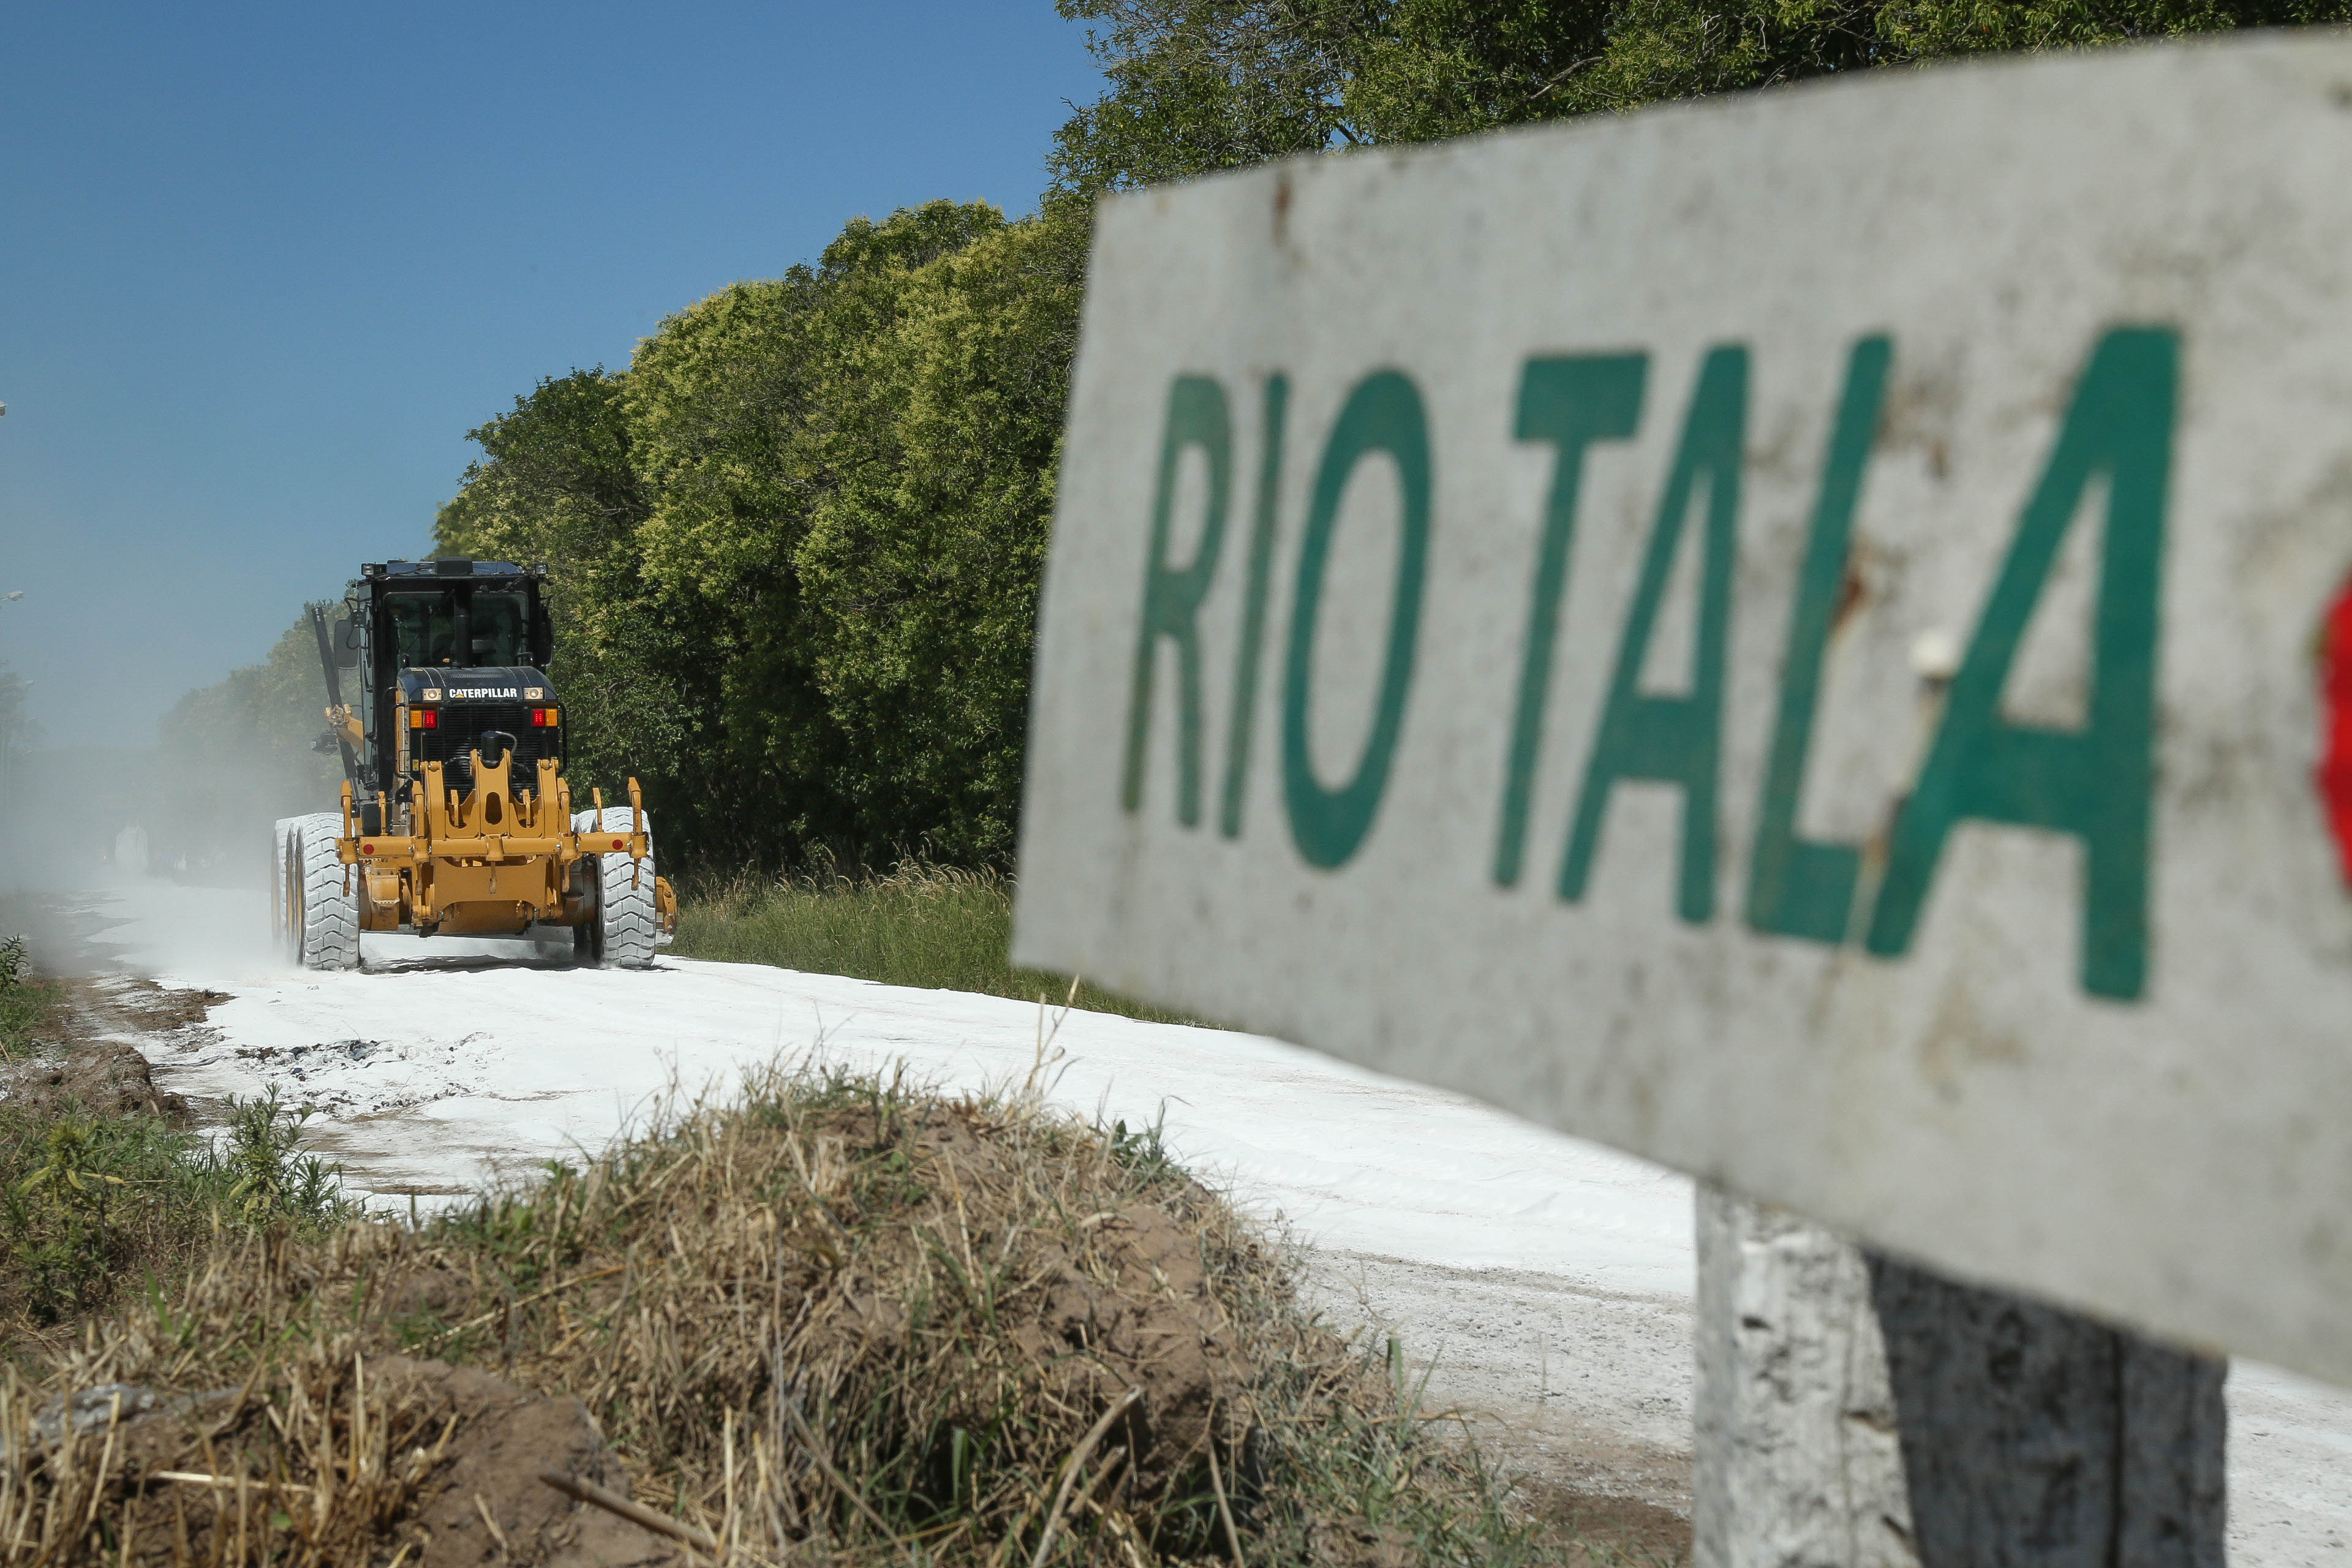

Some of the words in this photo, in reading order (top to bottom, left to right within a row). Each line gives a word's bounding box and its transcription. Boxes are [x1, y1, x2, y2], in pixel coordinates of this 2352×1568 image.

[449, 688, 518, 698] CATERPILLAR
[1122, 368, 1433, 870] RIO
[1493, 325, 2182, 1002] TALA
